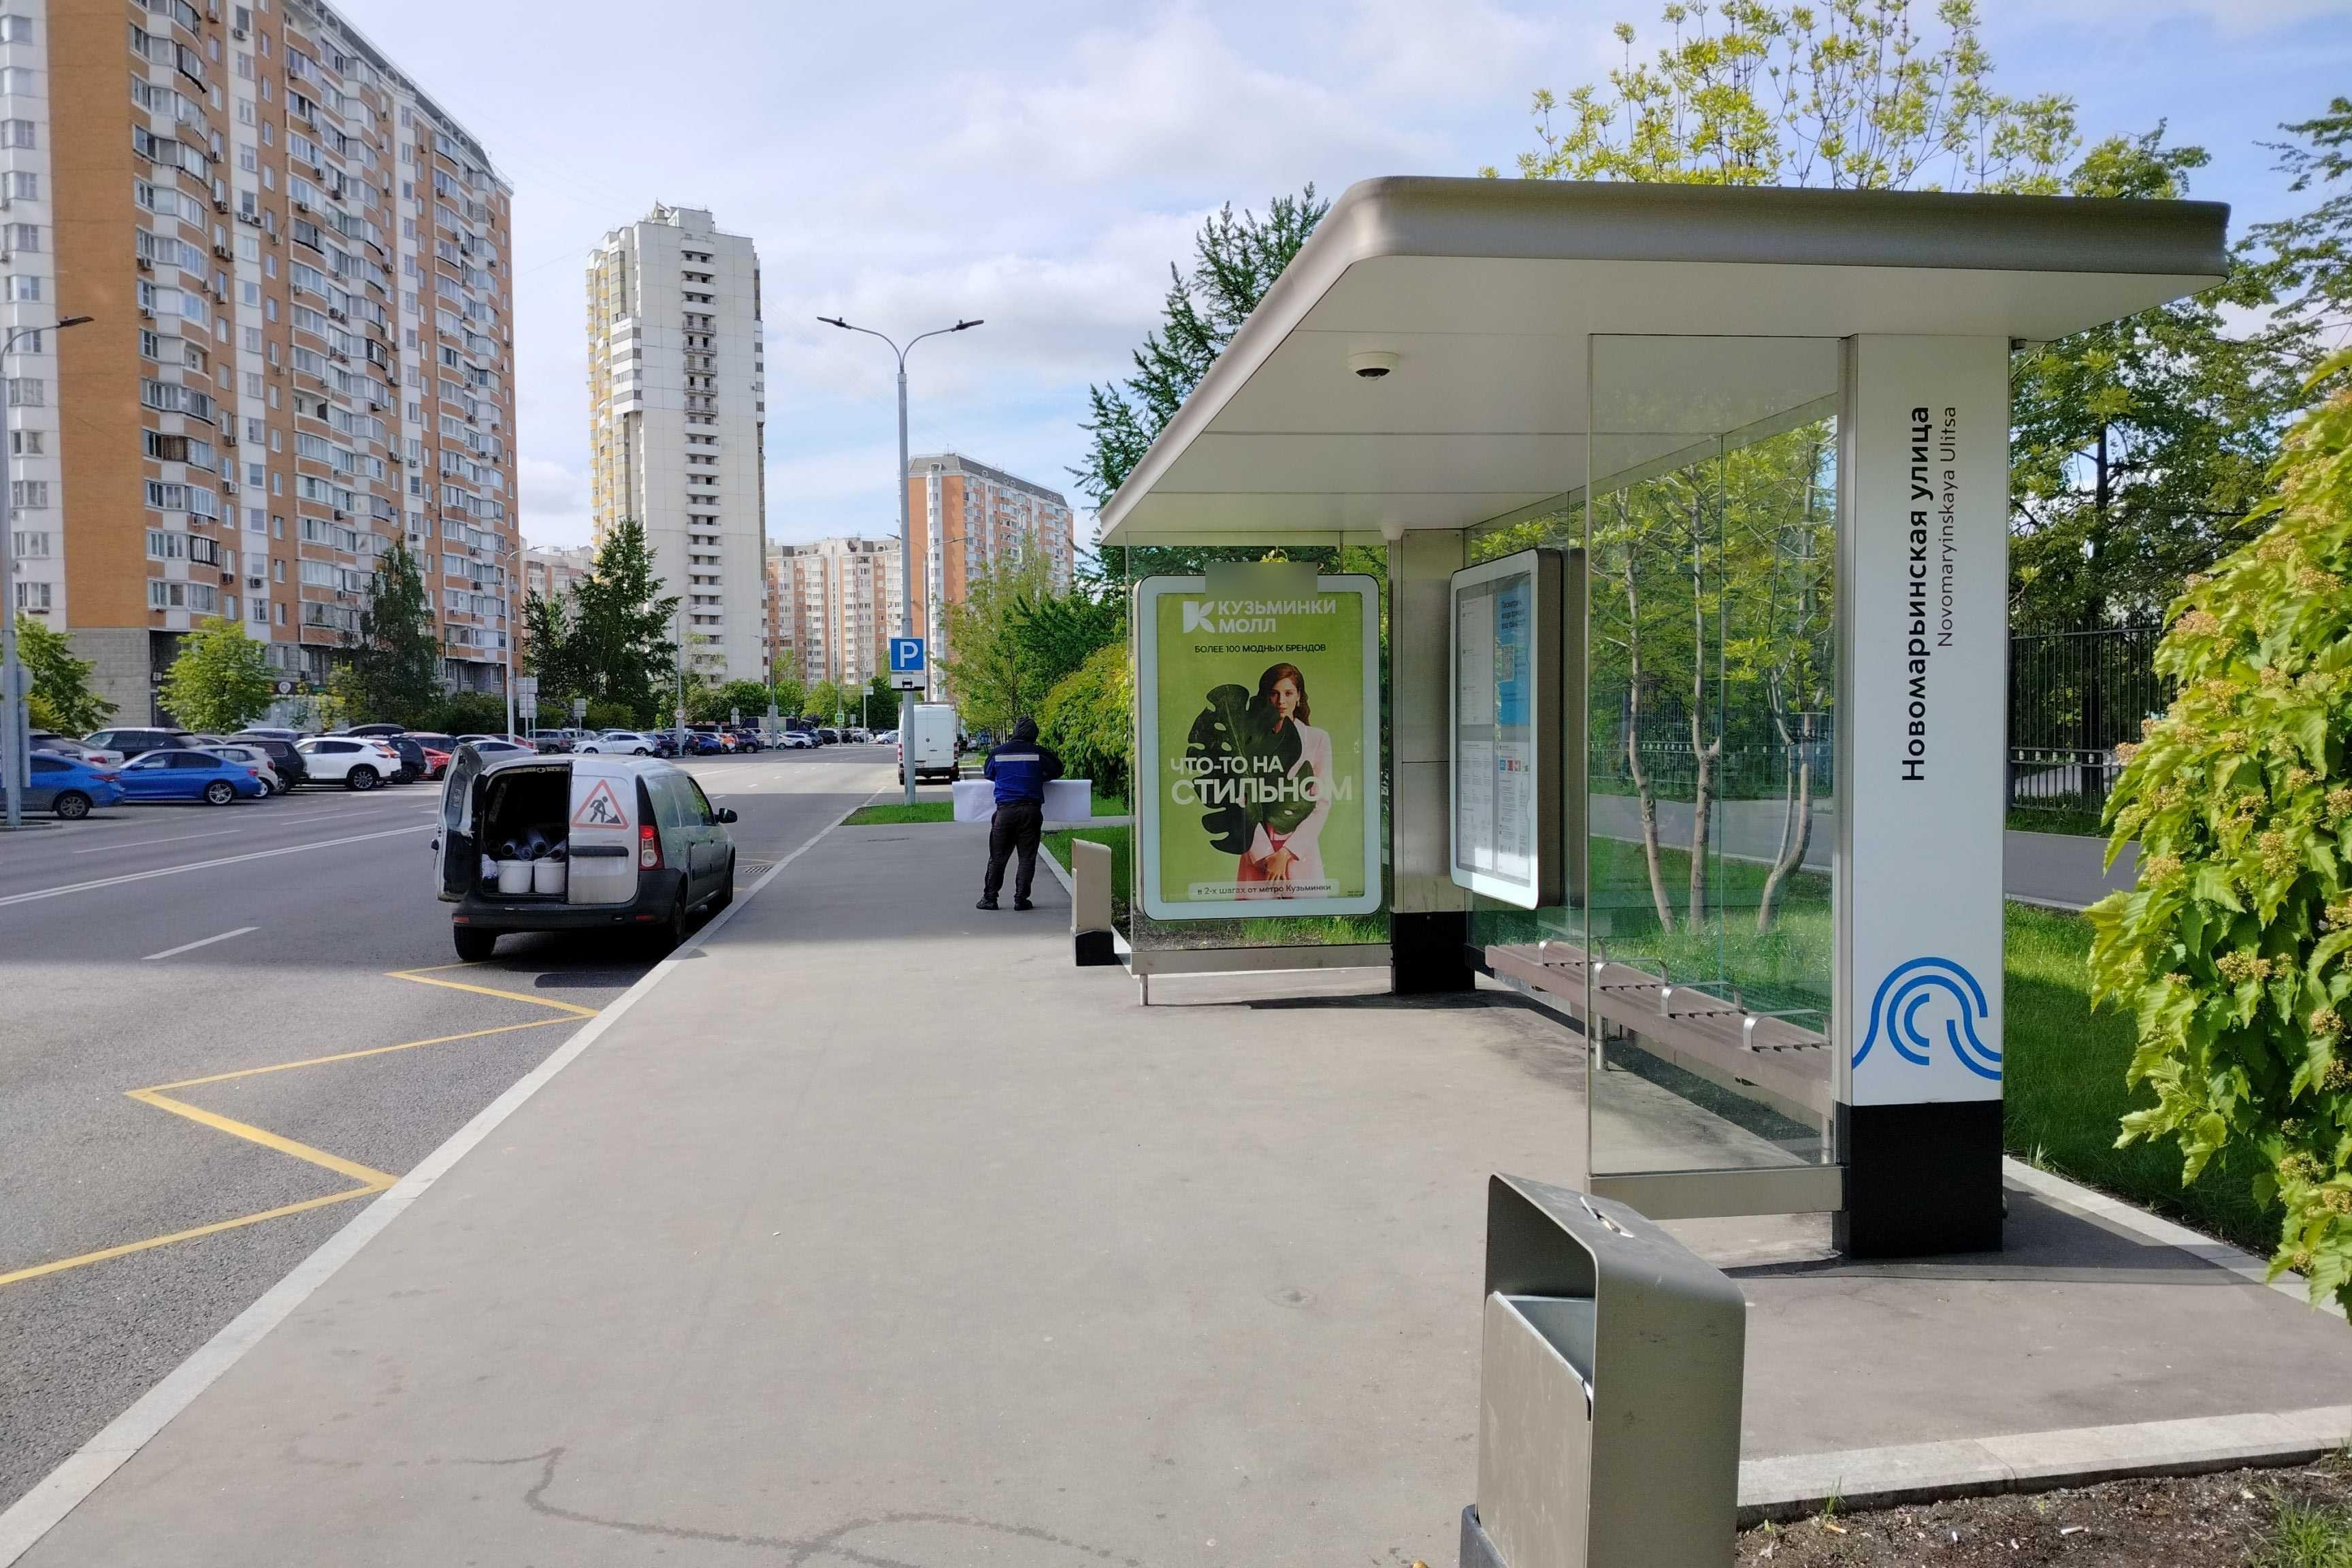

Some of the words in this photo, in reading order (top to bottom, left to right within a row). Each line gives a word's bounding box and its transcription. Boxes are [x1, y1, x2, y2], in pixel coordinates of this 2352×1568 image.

[1940, 406, 1956, 462] Ulitsa
[1911, 407, 1933, 501] улица
[1938, 470, 1959, 647] Novomaryinskaya
[1218, 599, 1337, 615] КУЗЬМИНКИ
[1219, 618, 1277, 634] МОЛЛ
[900, 641, 919, 668] P
[1194, 645, 1224, 653] БОЛЕЕ
[1226, 644, 1241, 653] 100
[1242, 644, 1284, 653] МОДНЫХ
[1286, 644, 1326, 653] БРЕНДОВ
[1901, 510, 1931, 781] Новомарьинская
[1170, 756, 1248, 775] ЧТО-ТО
[1253, 755, 1284, 774] НА
[1171, 775, 1353, 806] СТИЛЬНОМ
[1259, 886, 1284, 894] метро
[1286, 885, 1332, 894] Кузьминки
